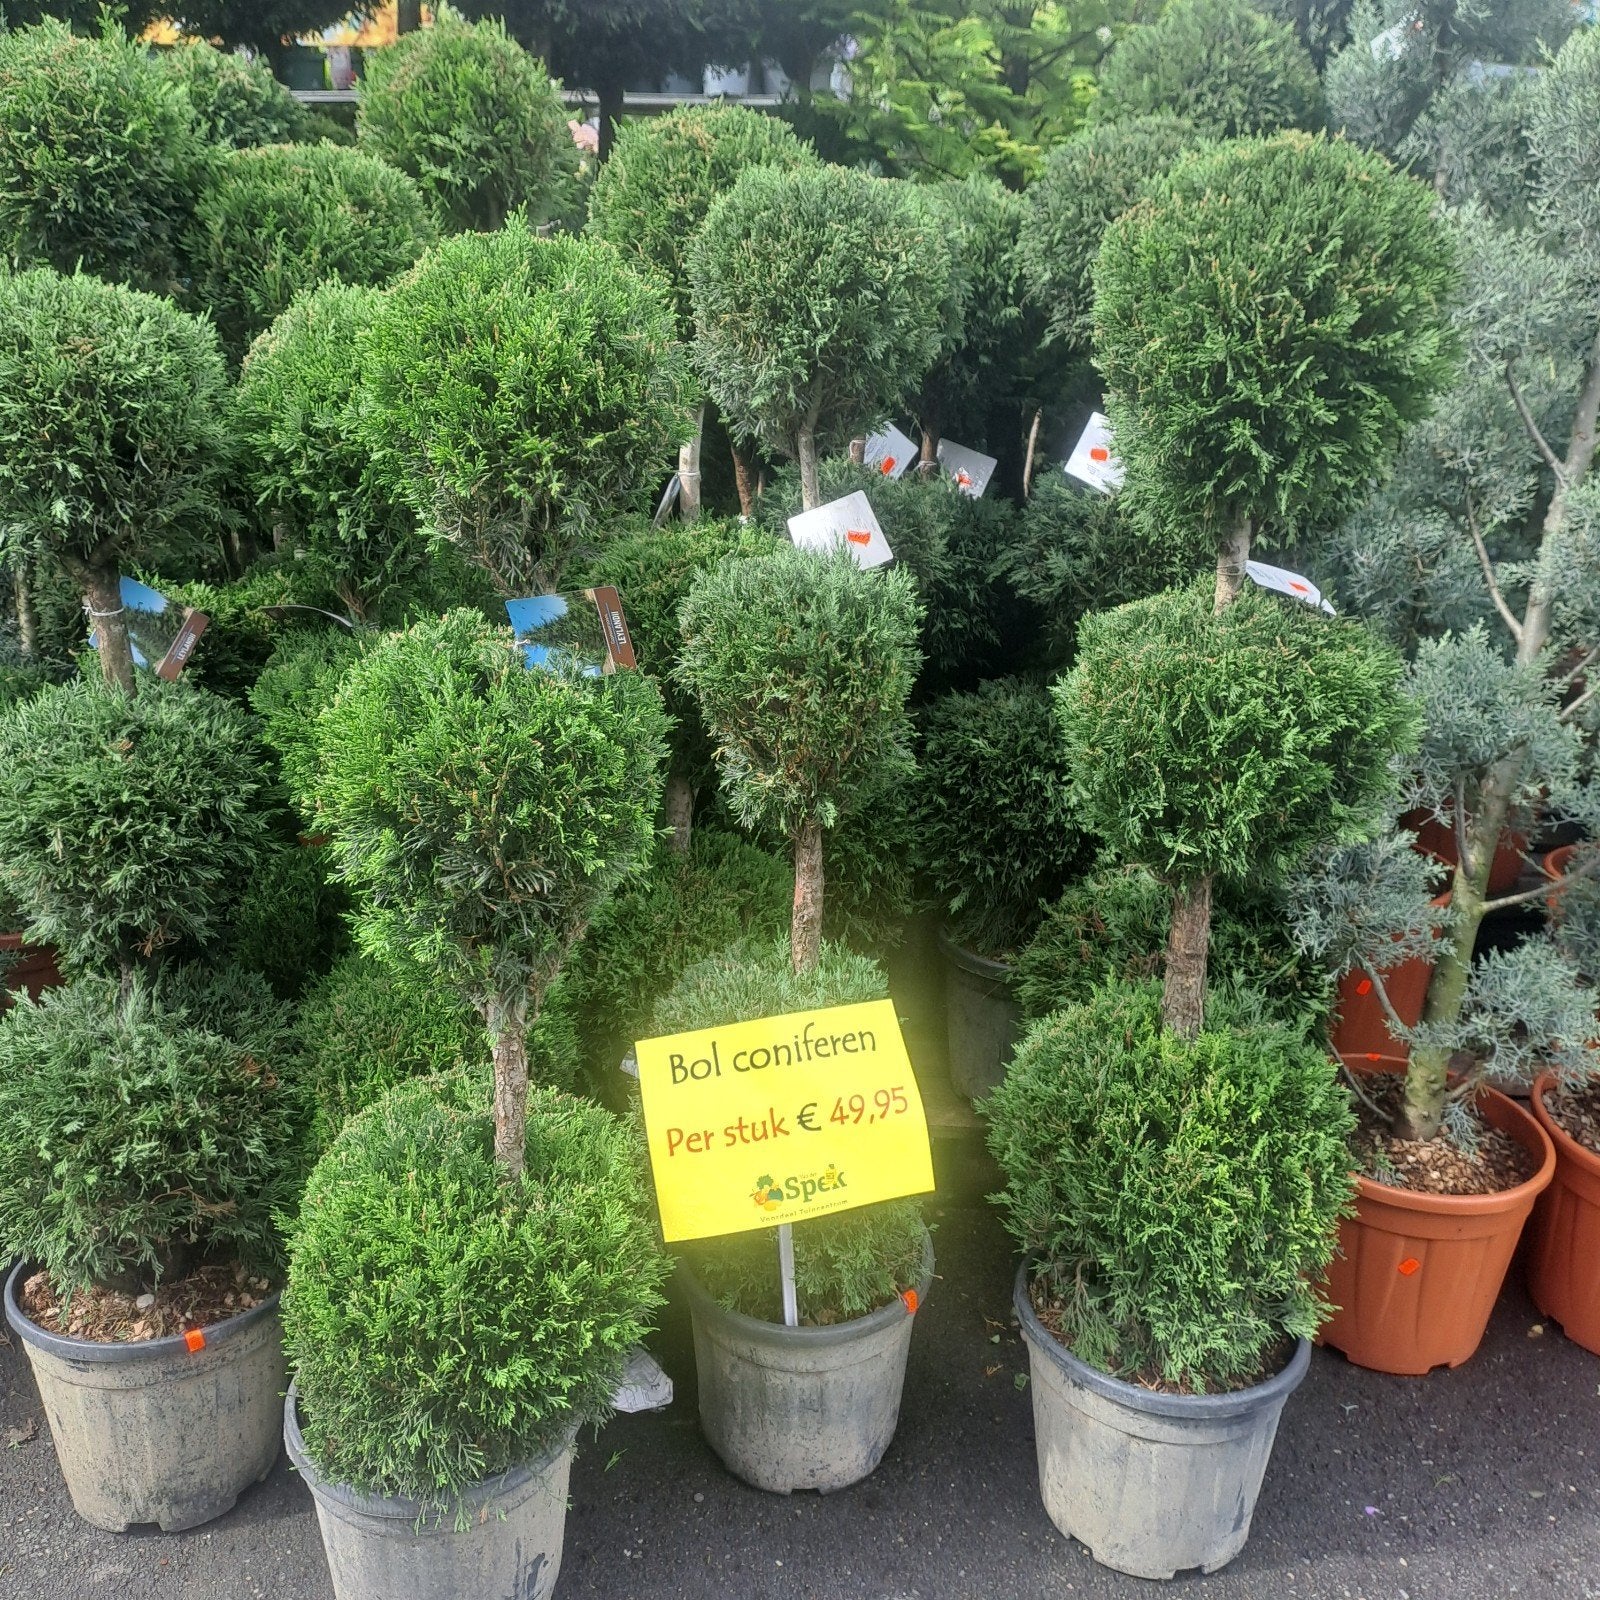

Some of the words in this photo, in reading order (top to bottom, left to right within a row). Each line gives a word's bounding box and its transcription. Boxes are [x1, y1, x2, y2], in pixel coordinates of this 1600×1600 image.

[669, 1041, 721, 1085] Bol
[732, 1022, 876, 1073] coniferen
[666, 1127, 714, 1157] Per
[725, 1107, 790, 1147] stuk
[796, 1102, 822, 1132] €
[829, 1086, 909, 1125] 49,95
[784, 1171, 847, 1203] Spek
